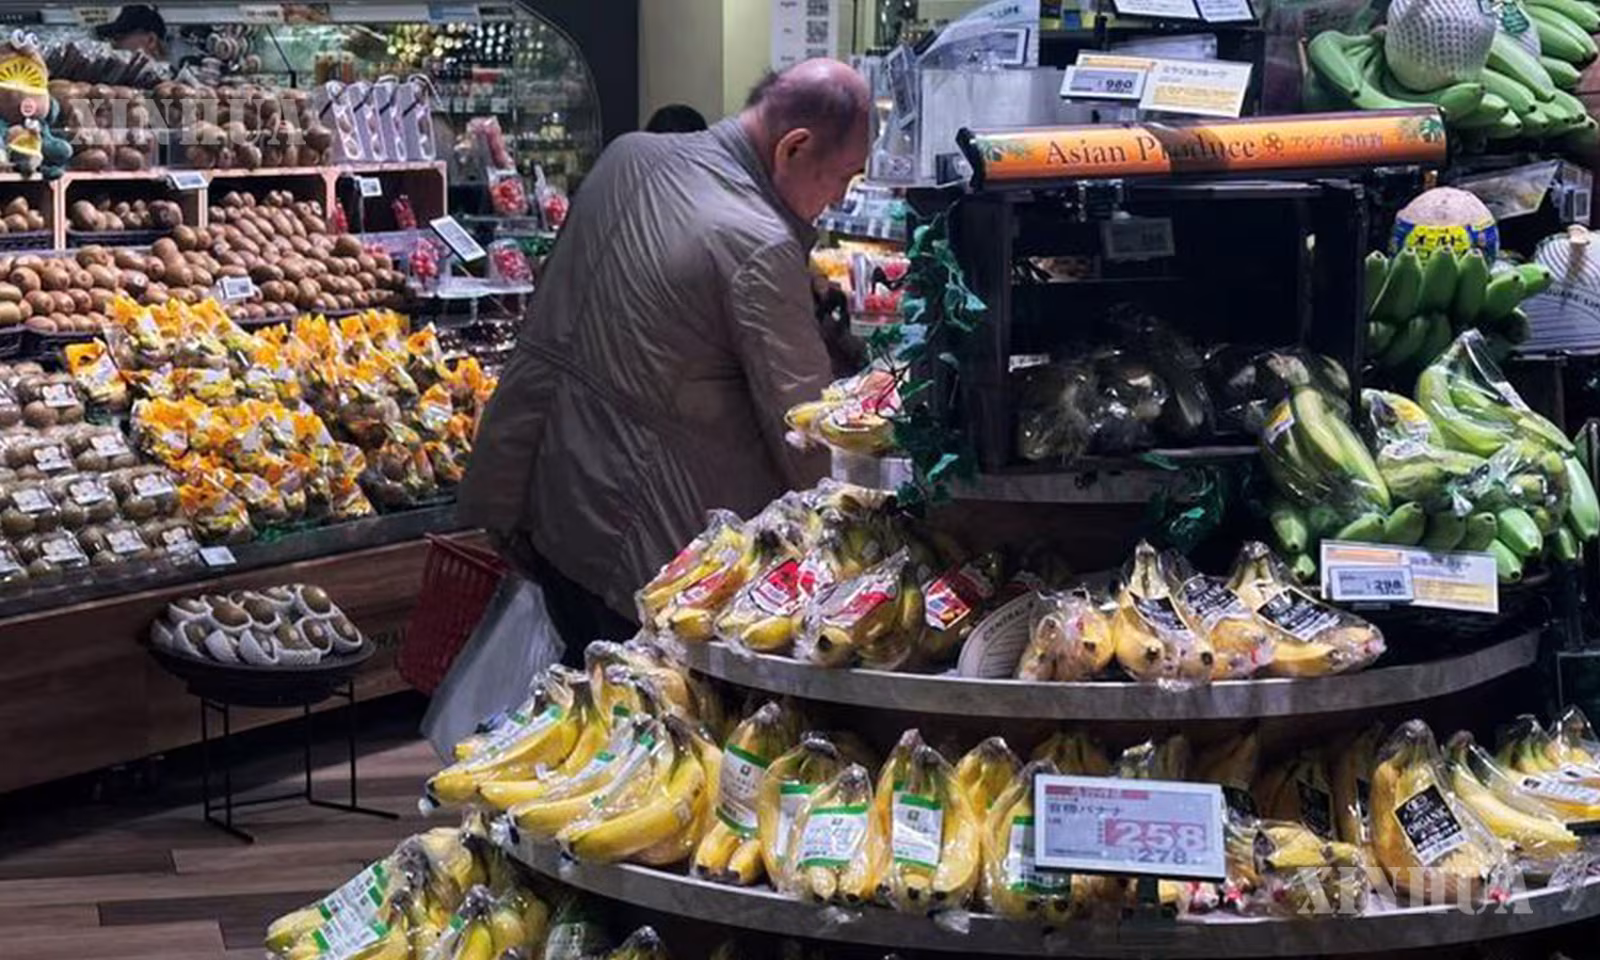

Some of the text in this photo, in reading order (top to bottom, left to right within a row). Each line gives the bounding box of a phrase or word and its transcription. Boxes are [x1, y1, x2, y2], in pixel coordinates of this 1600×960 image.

[1105, 79, 1133, 90] 980
[1046, 133, 1255, 165] Asian Produce
[1113, 821, 1207, 851] 258
[1137, 850, 1187, 865] 278
